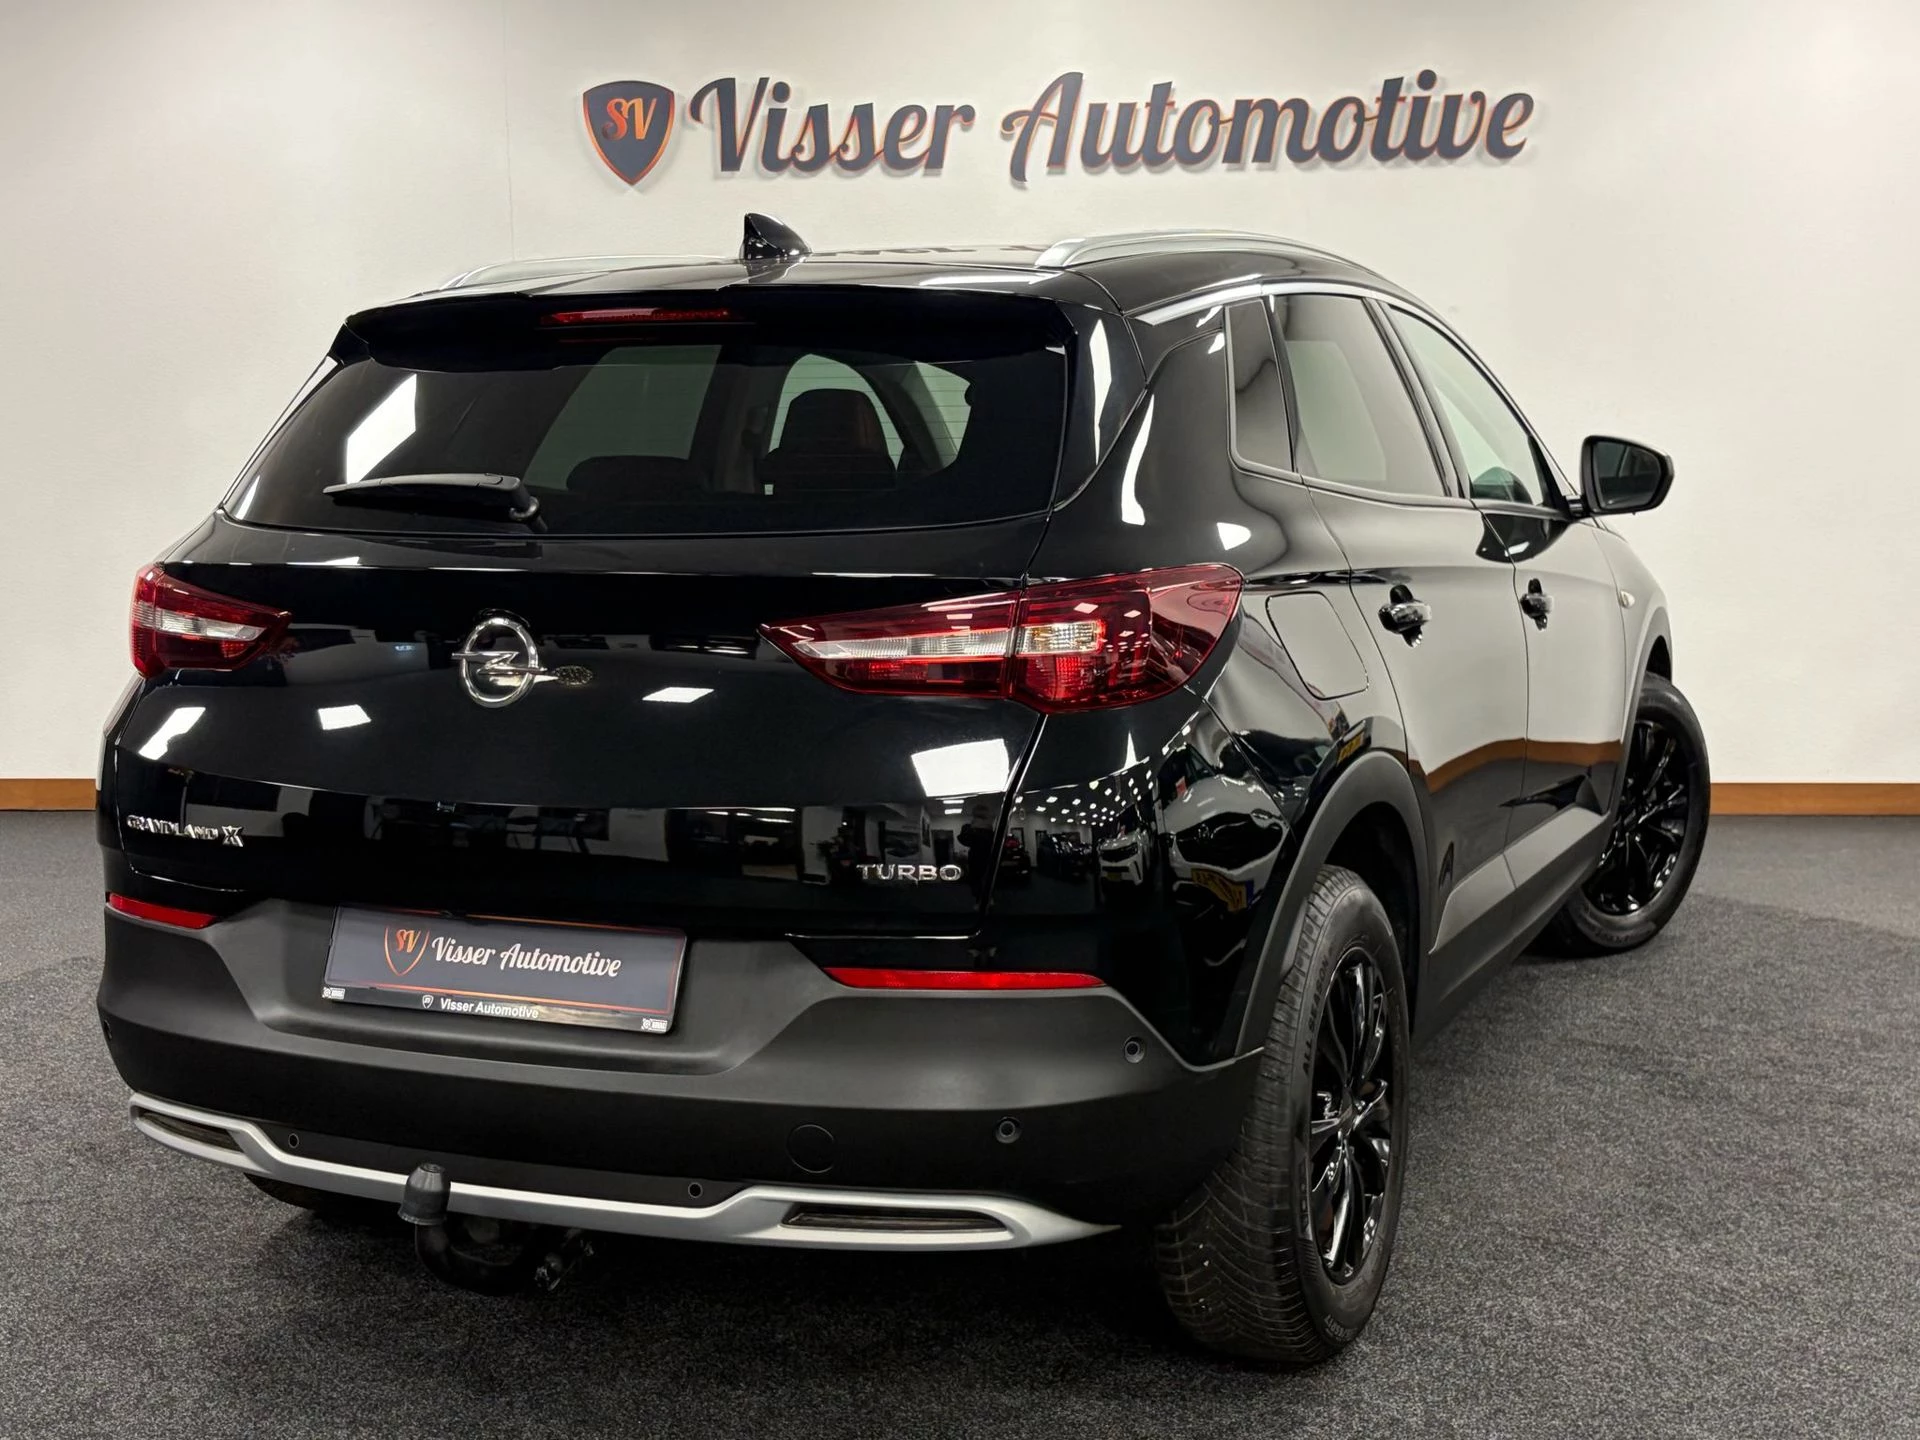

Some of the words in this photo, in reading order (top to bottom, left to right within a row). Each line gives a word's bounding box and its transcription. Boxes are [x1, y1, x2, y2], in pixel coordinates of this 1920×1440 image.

[688, 76, 976, 172] Visser
[1000, 68, 1535, 183] Automotive
[221, 824, 244, 847] X
[856, 863, 962, 882] TURBO
[431, 936, 497, 966] Visser
[499, 943, 623, 978] Automotive
[440, 997, 475, 1013] Visser
[475, 1001, 540, 1019] Automotive
